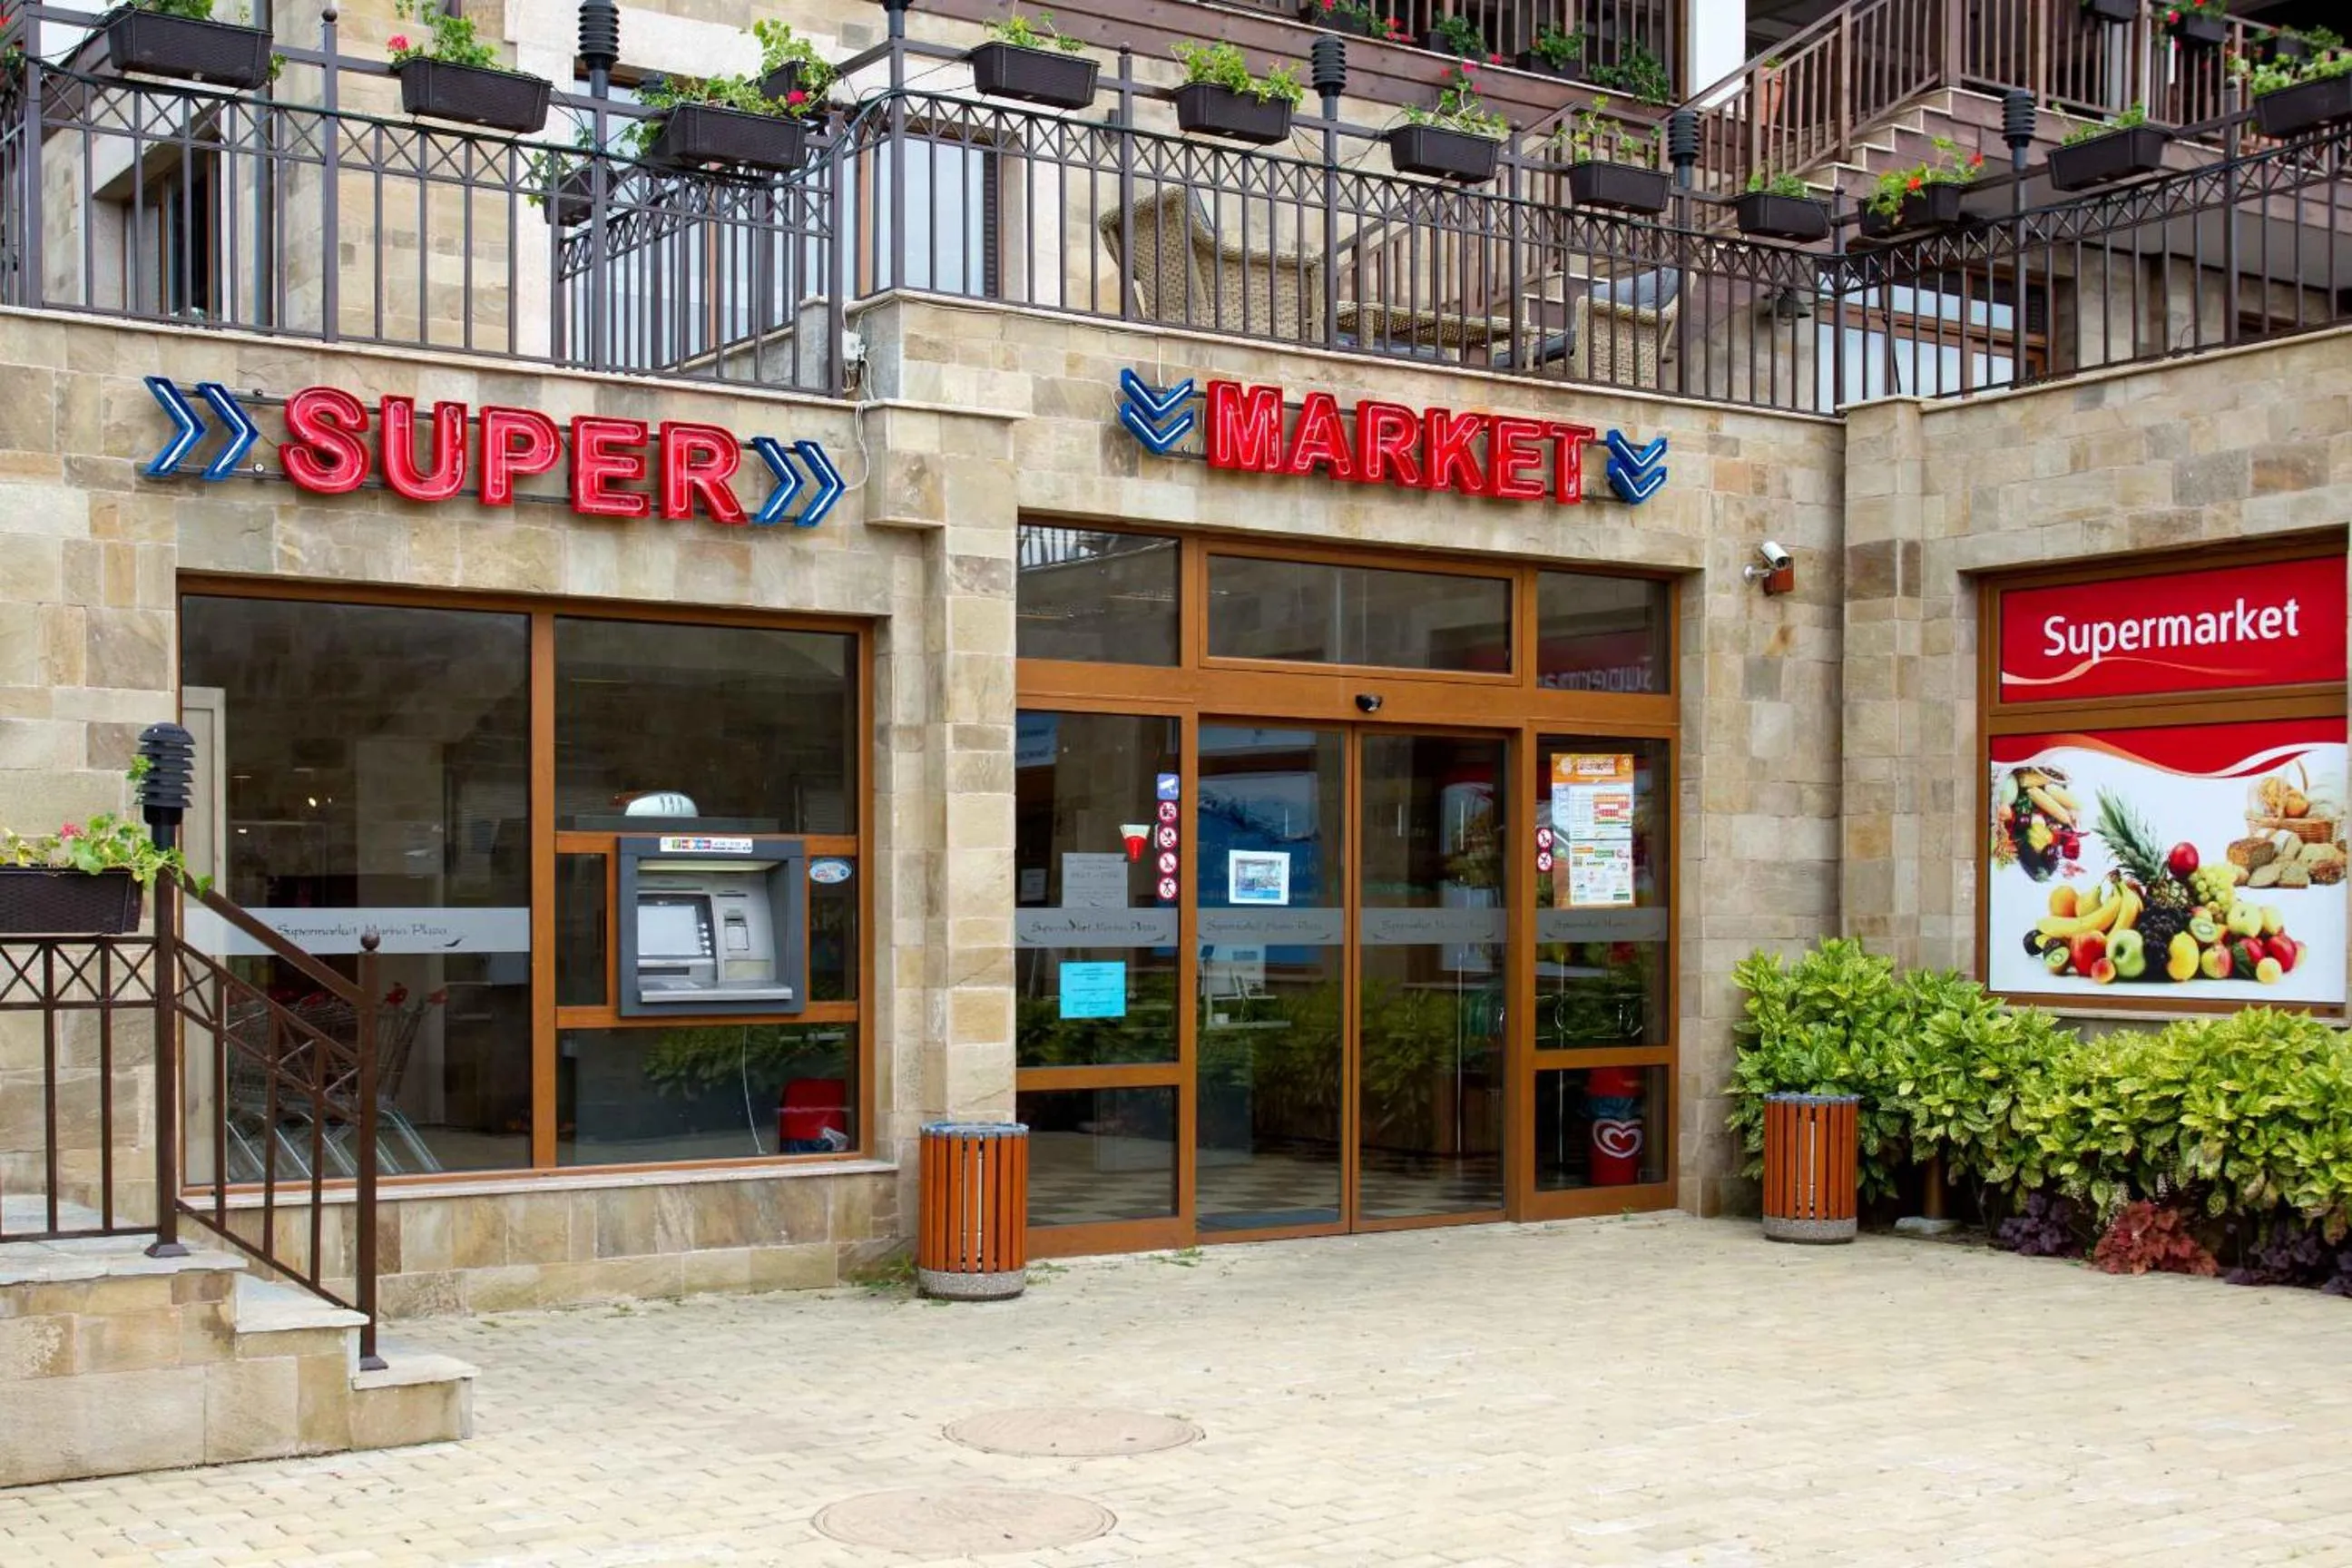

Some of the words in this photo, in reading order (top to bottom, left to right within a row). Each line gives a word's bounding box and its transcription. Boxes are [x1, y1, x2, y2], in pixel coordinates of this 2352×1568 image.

[279, 387, 749, 524] SUPER
[1206, 379, 1596, 505] MARKET
[2043, 598, 2299, 663] Supermarket
[277, 922, 358, 939] Supermarket
